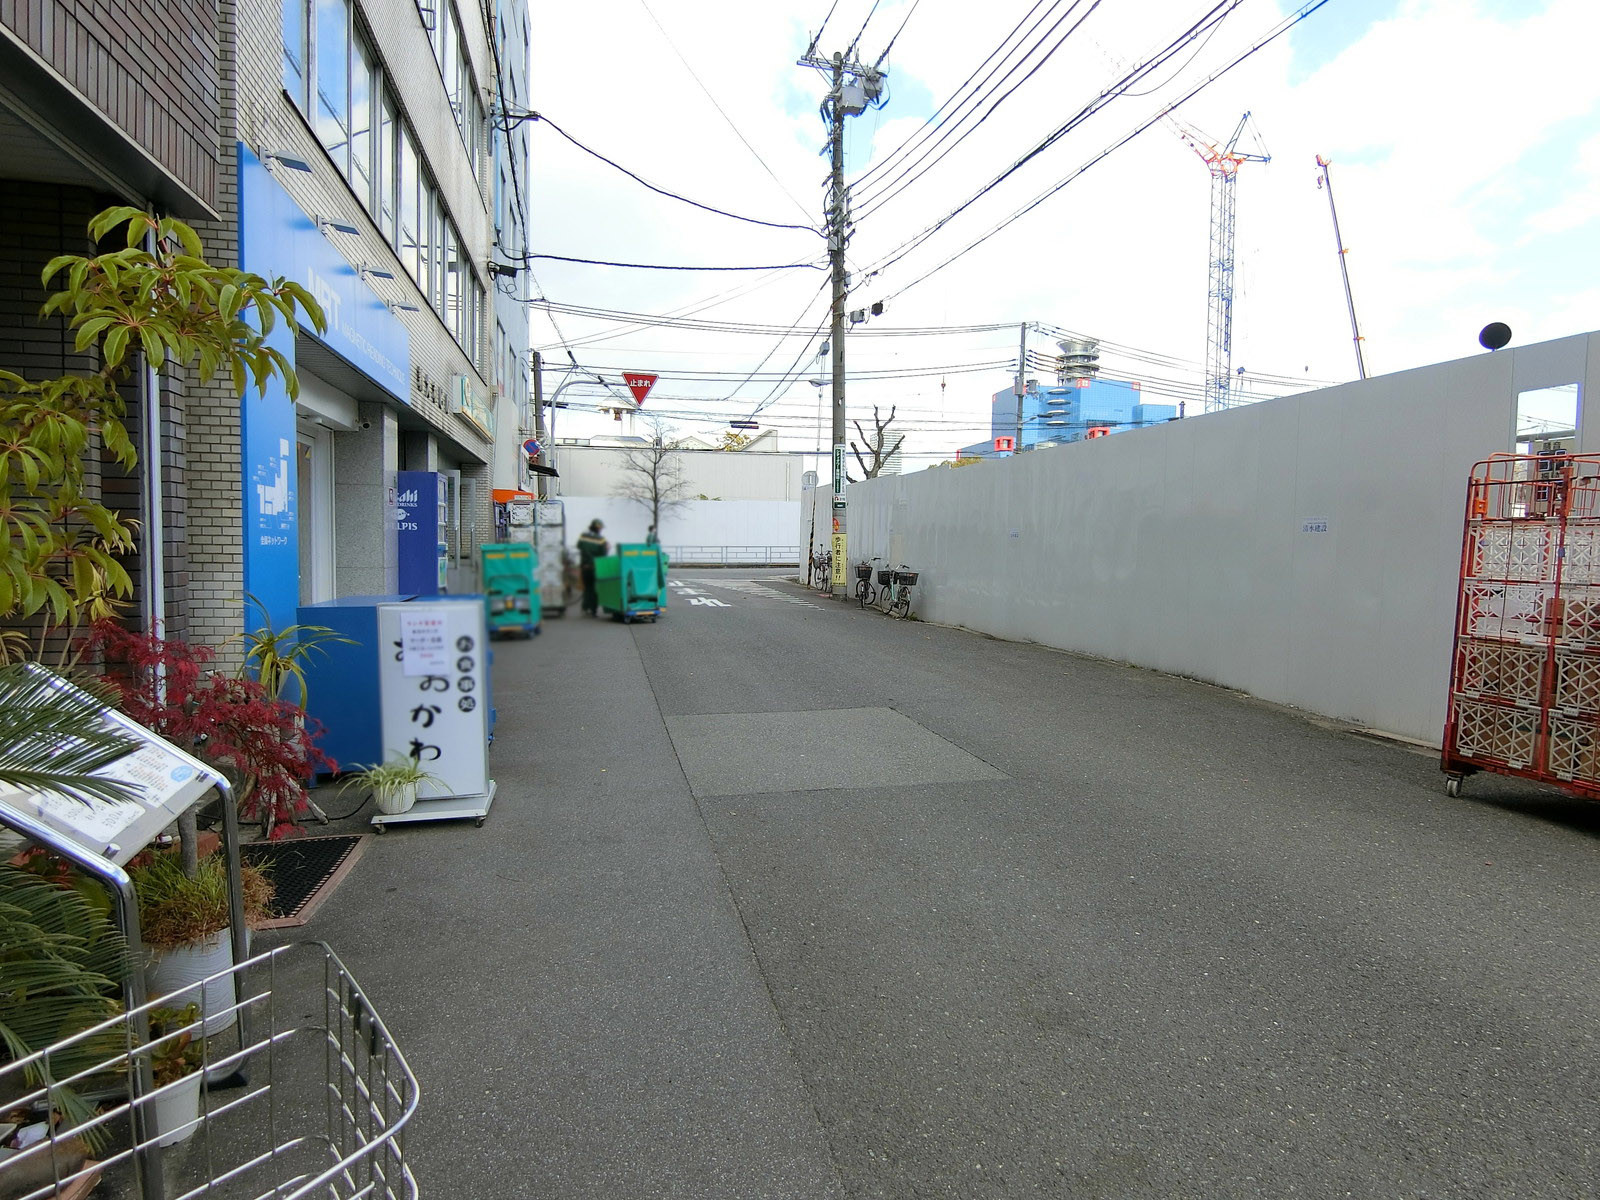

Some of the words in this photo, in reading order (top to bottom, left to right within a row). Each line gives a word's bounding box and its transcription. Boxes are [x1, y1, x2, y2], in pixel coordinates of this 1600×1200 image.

[630, 378, 651, 387] 止まれ
[398, 522, 418, 530] LPIS
